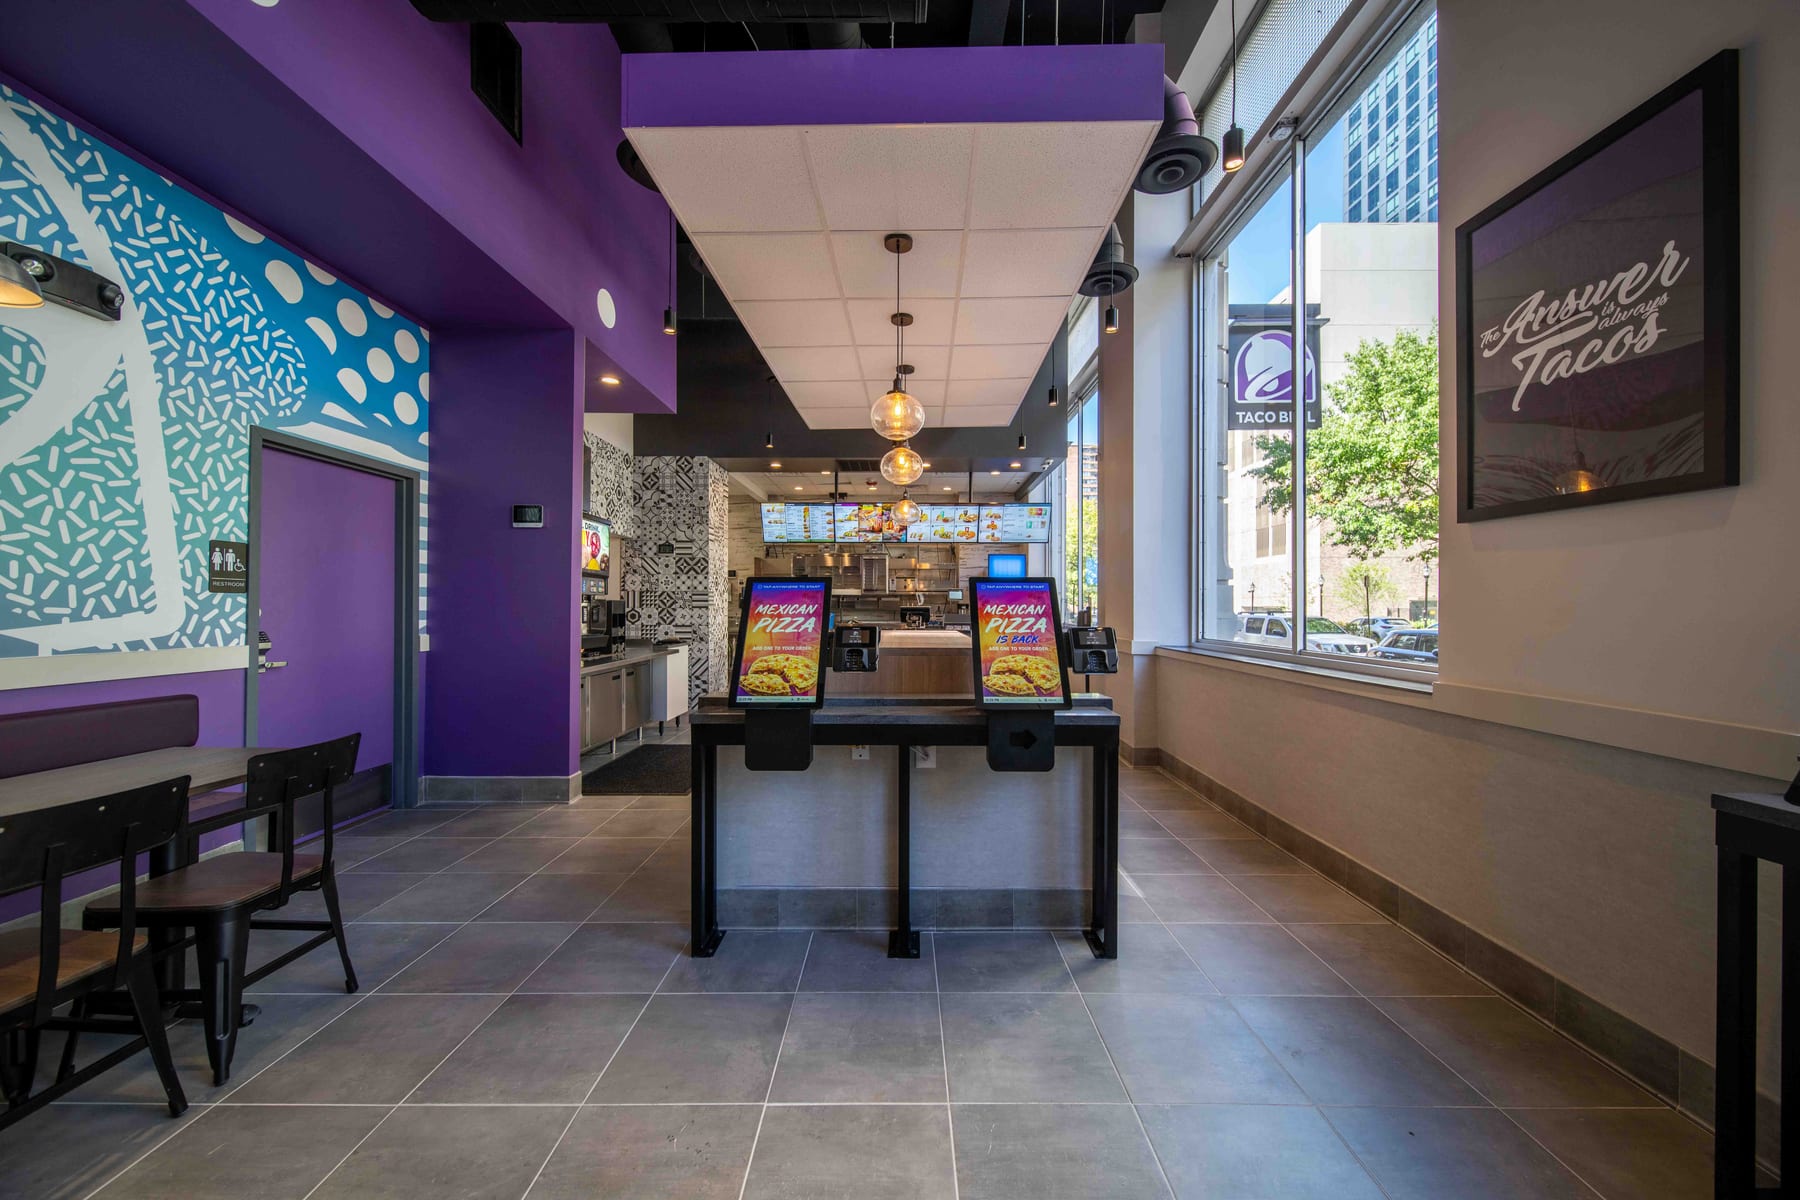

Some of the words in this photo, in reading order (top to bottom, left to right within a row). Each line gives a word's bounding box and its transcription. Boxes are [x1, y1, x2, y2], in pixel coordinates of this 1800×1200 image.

[1483, 240, 1690, 358] Answer
[1598, 292, 1670, 330] always
[1601, 301, 1615, 316] is
[1480, 325, 1501, 348] The
[1512, 312, 1667, 412] Tacos
[1236, 411, 1275, 423] TACO
[1279, 411, 1315, 423] BL
[755, 604, 818, 615] MEXICAN
[984, 604, 1046, 615] MEXICAN
[752, 617, 816, 633] PIZZA
[985, 617, 1047, 633] PIZZA
[996, 635, 1008, 644] IS
[1012, 635, 1039, 644] BACK
